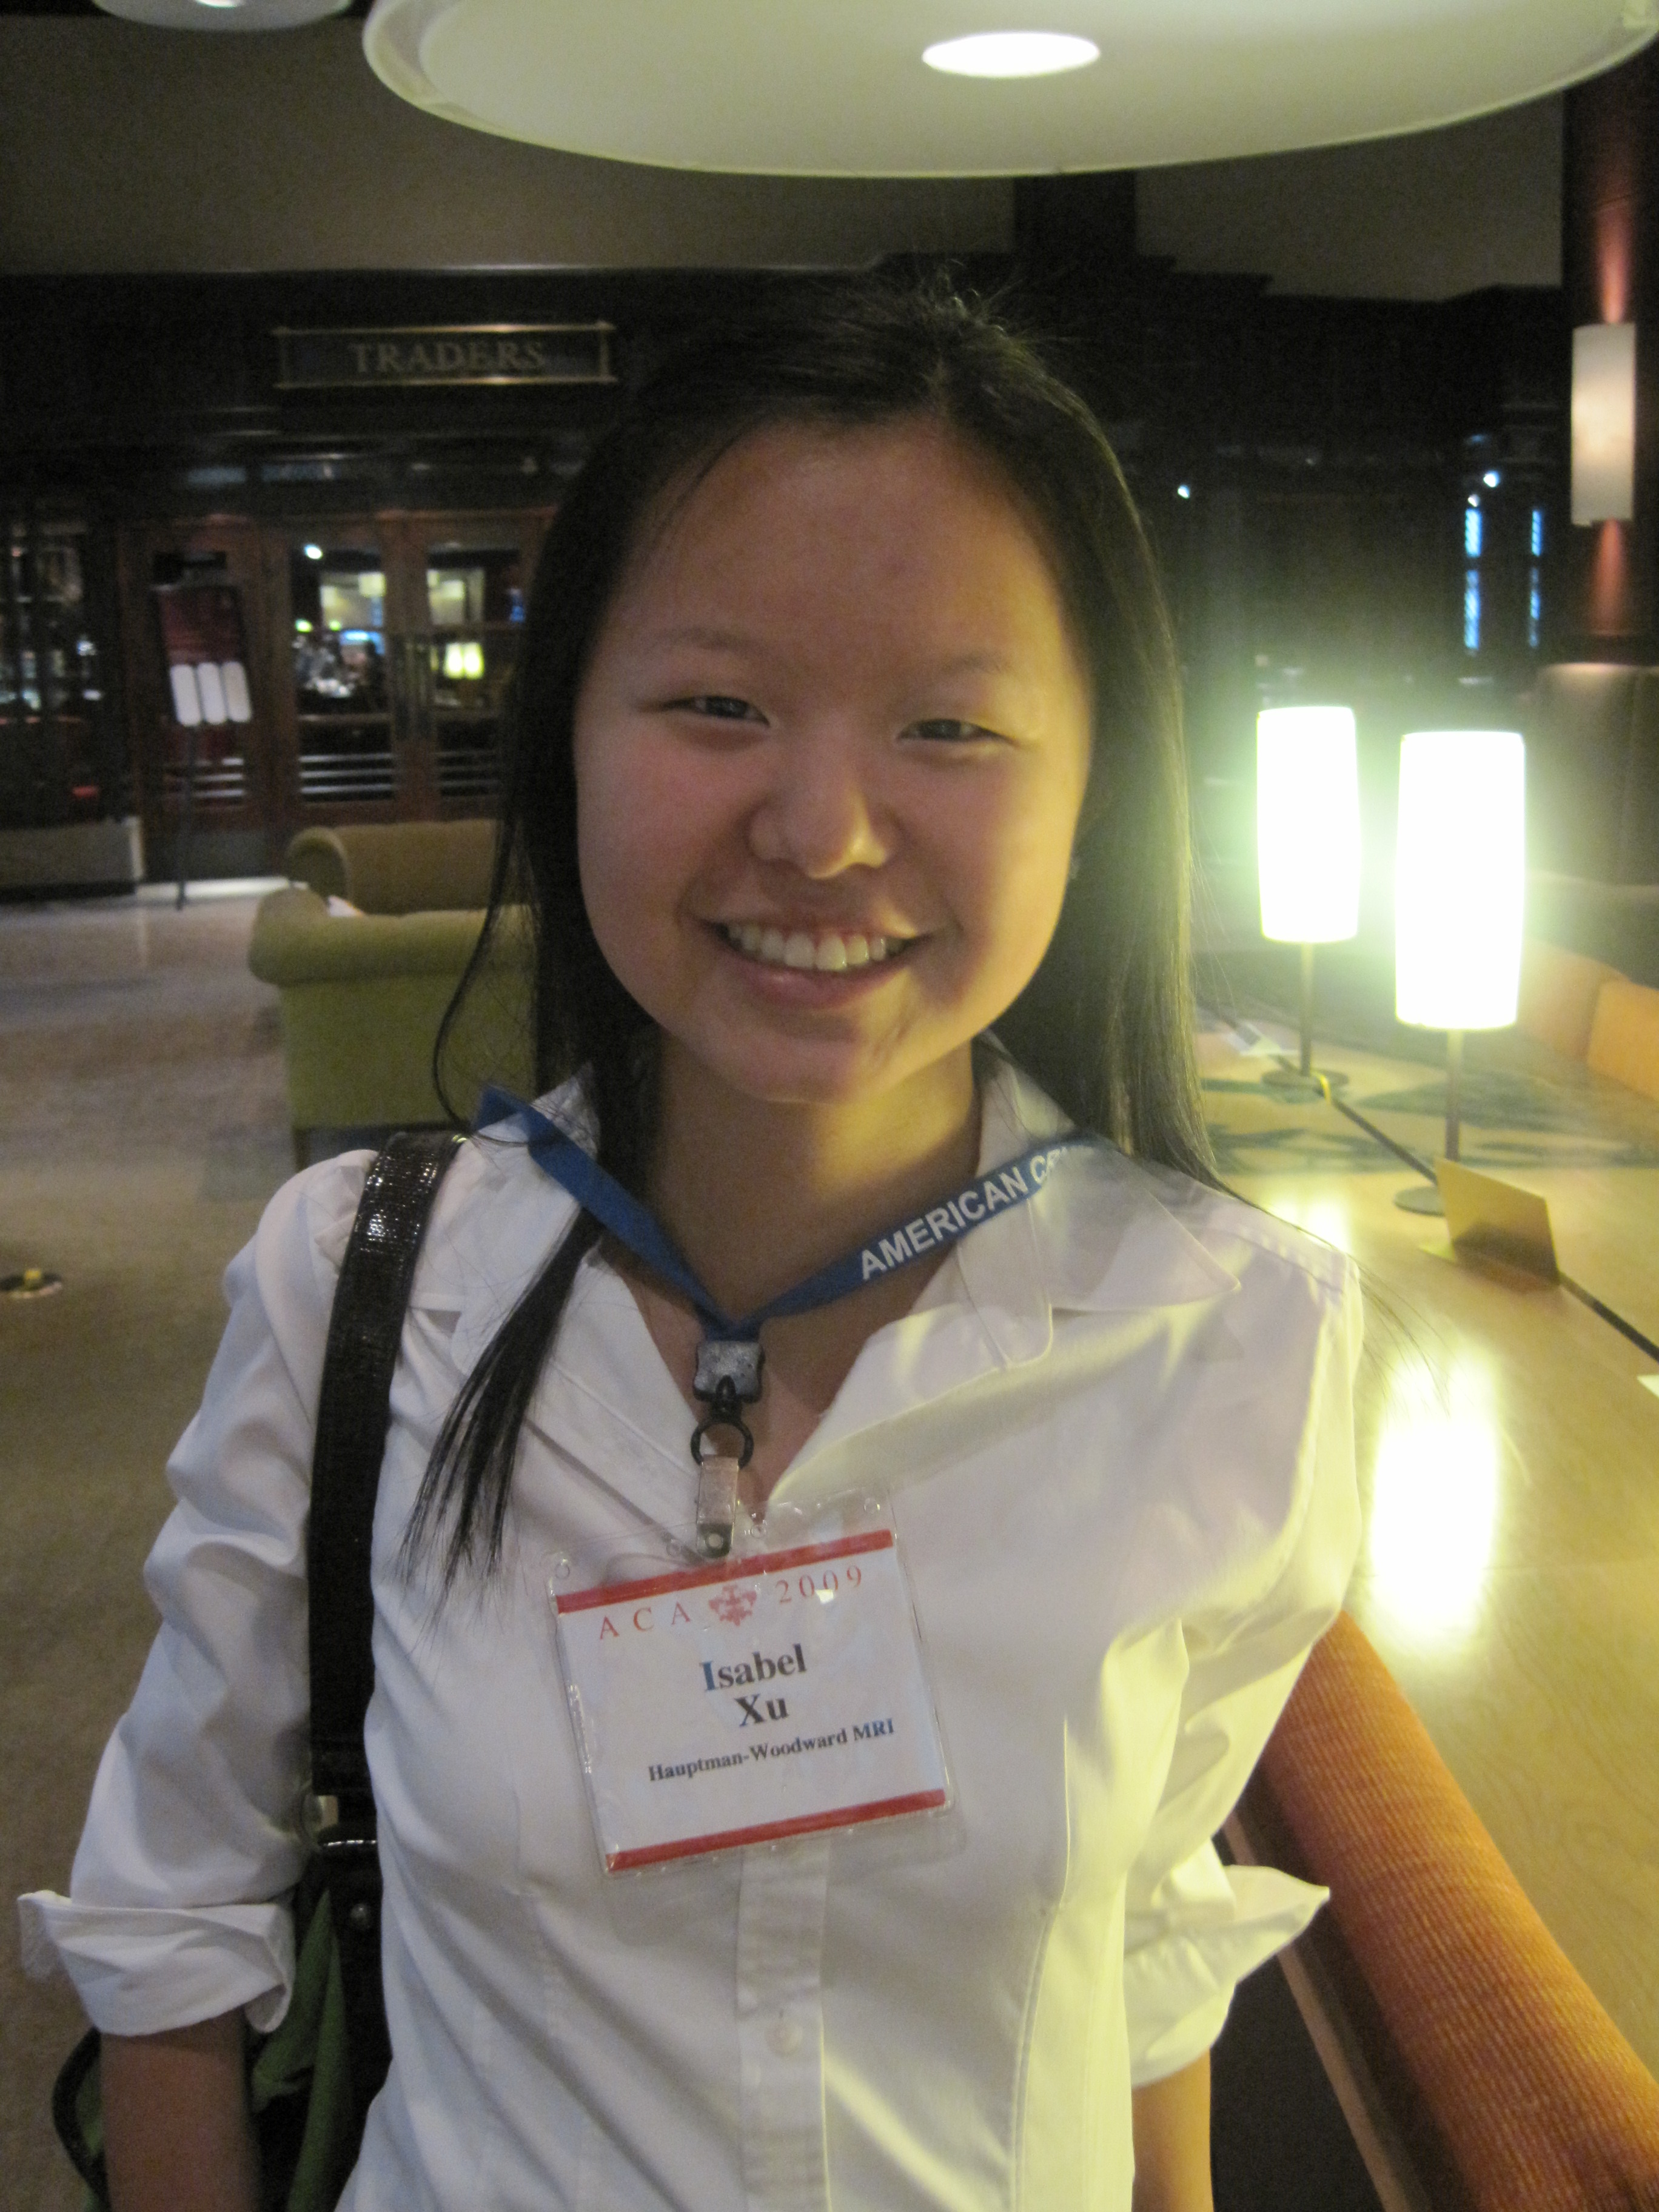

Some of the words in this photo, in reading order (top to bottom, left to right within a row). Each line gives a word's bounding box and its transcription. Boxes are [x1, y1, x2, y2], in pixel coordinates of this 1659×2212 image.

[348, 341, 546, 372] TRADERS
[860, 1165, 1029, 1280] AMERICAN
[775, 1564, 862, 1604] 2009
[700, 1643, 807, 1691] Isabel
[735, 1694, 789, 1727] Xu
[648, 1727, 848, 1781] Hauptman-Woodward
[853, 1717, 895, 1741] MRI
